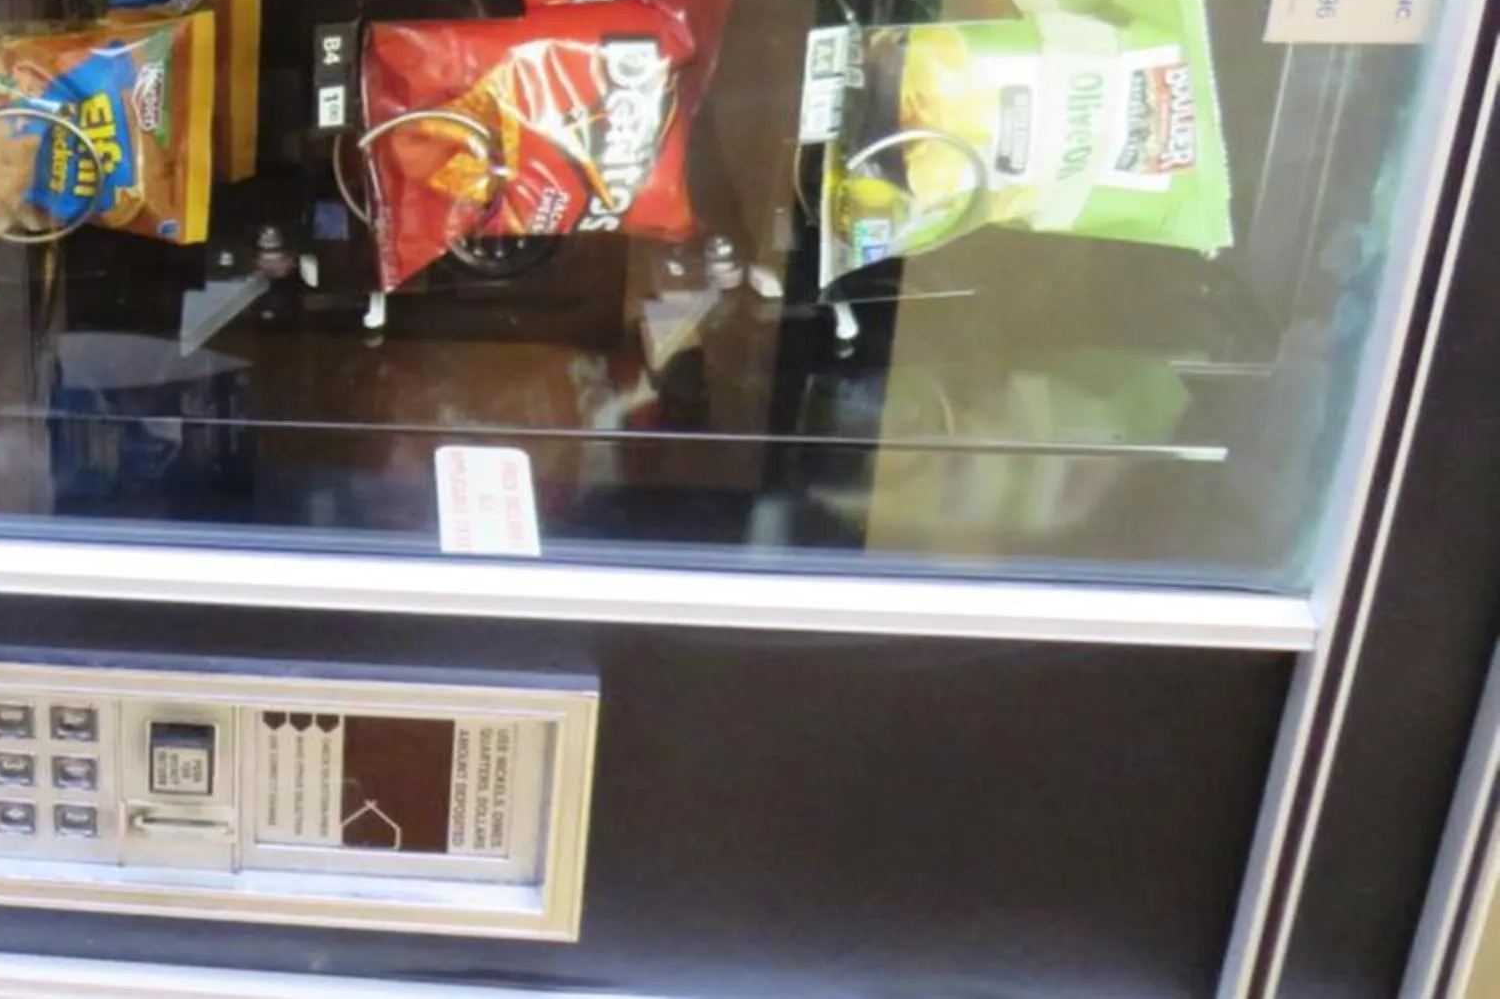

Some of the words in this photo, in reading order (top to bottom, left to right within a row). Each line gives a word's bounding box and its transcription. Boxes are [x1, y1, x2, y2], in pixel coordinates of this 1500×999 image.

[322, 36, 342, 65] B4
[577, 39, 660, 235] Doritos
[1066, 72, 1105, 146] Olive
[1159, 67, 1196, 169] BOULDER
[72, 92, 123, 198] Elfin
[456, 728, 471, 779] AMOUNT
[451, 782, 468, 848] DEPOSITED
[473, 796, 488, 850] DOLLARS
